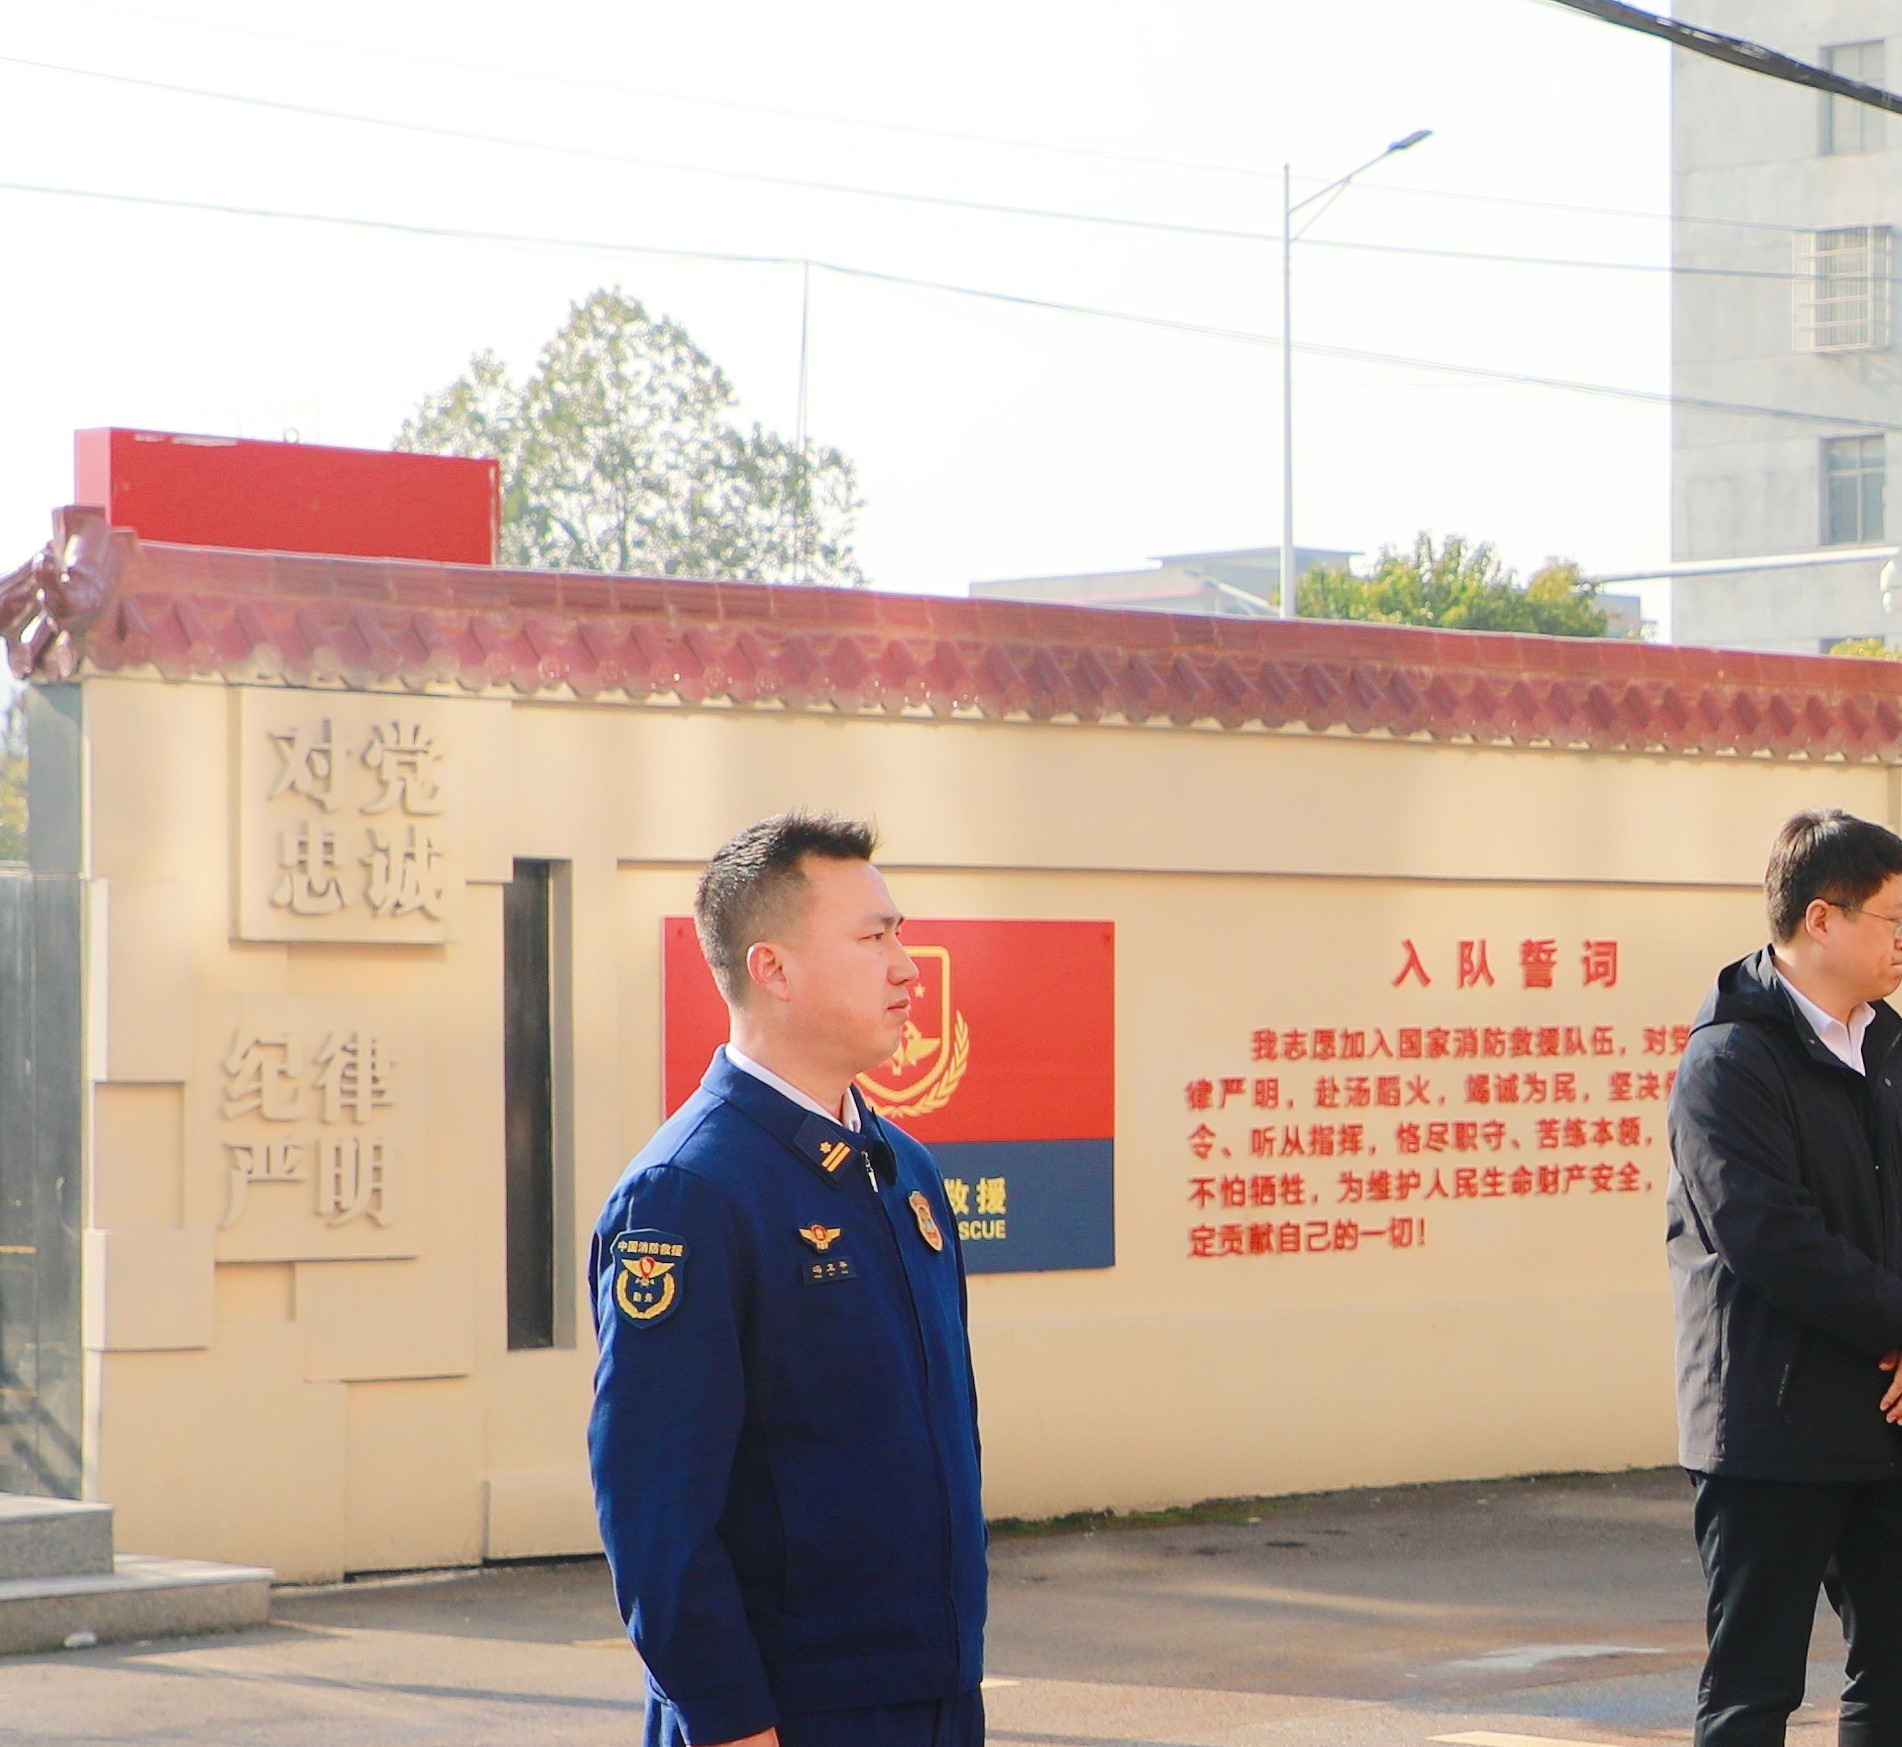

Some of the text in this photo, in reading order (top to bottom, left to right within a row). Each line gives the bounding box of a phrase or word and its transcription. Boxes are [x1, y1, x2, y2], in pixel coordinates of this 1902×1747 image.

[267, 718, 445, 818] 对党
[270, 820, 445, 921] 忠诚
[1391, 938, 1619, 989] 入队誓词
[219, 1030, 395, 1124] 纪律
[1252, 1023, 1691, 1062] 我志愿加入国家消防救援队伍，对党
[217, 1134, 393, 1231] 严明
[1188, 1159, 1653, 1209] 不怕牺牲，为维护人民生命财产安全，
[617, 1239, 684, 1257] 中国消防救援
